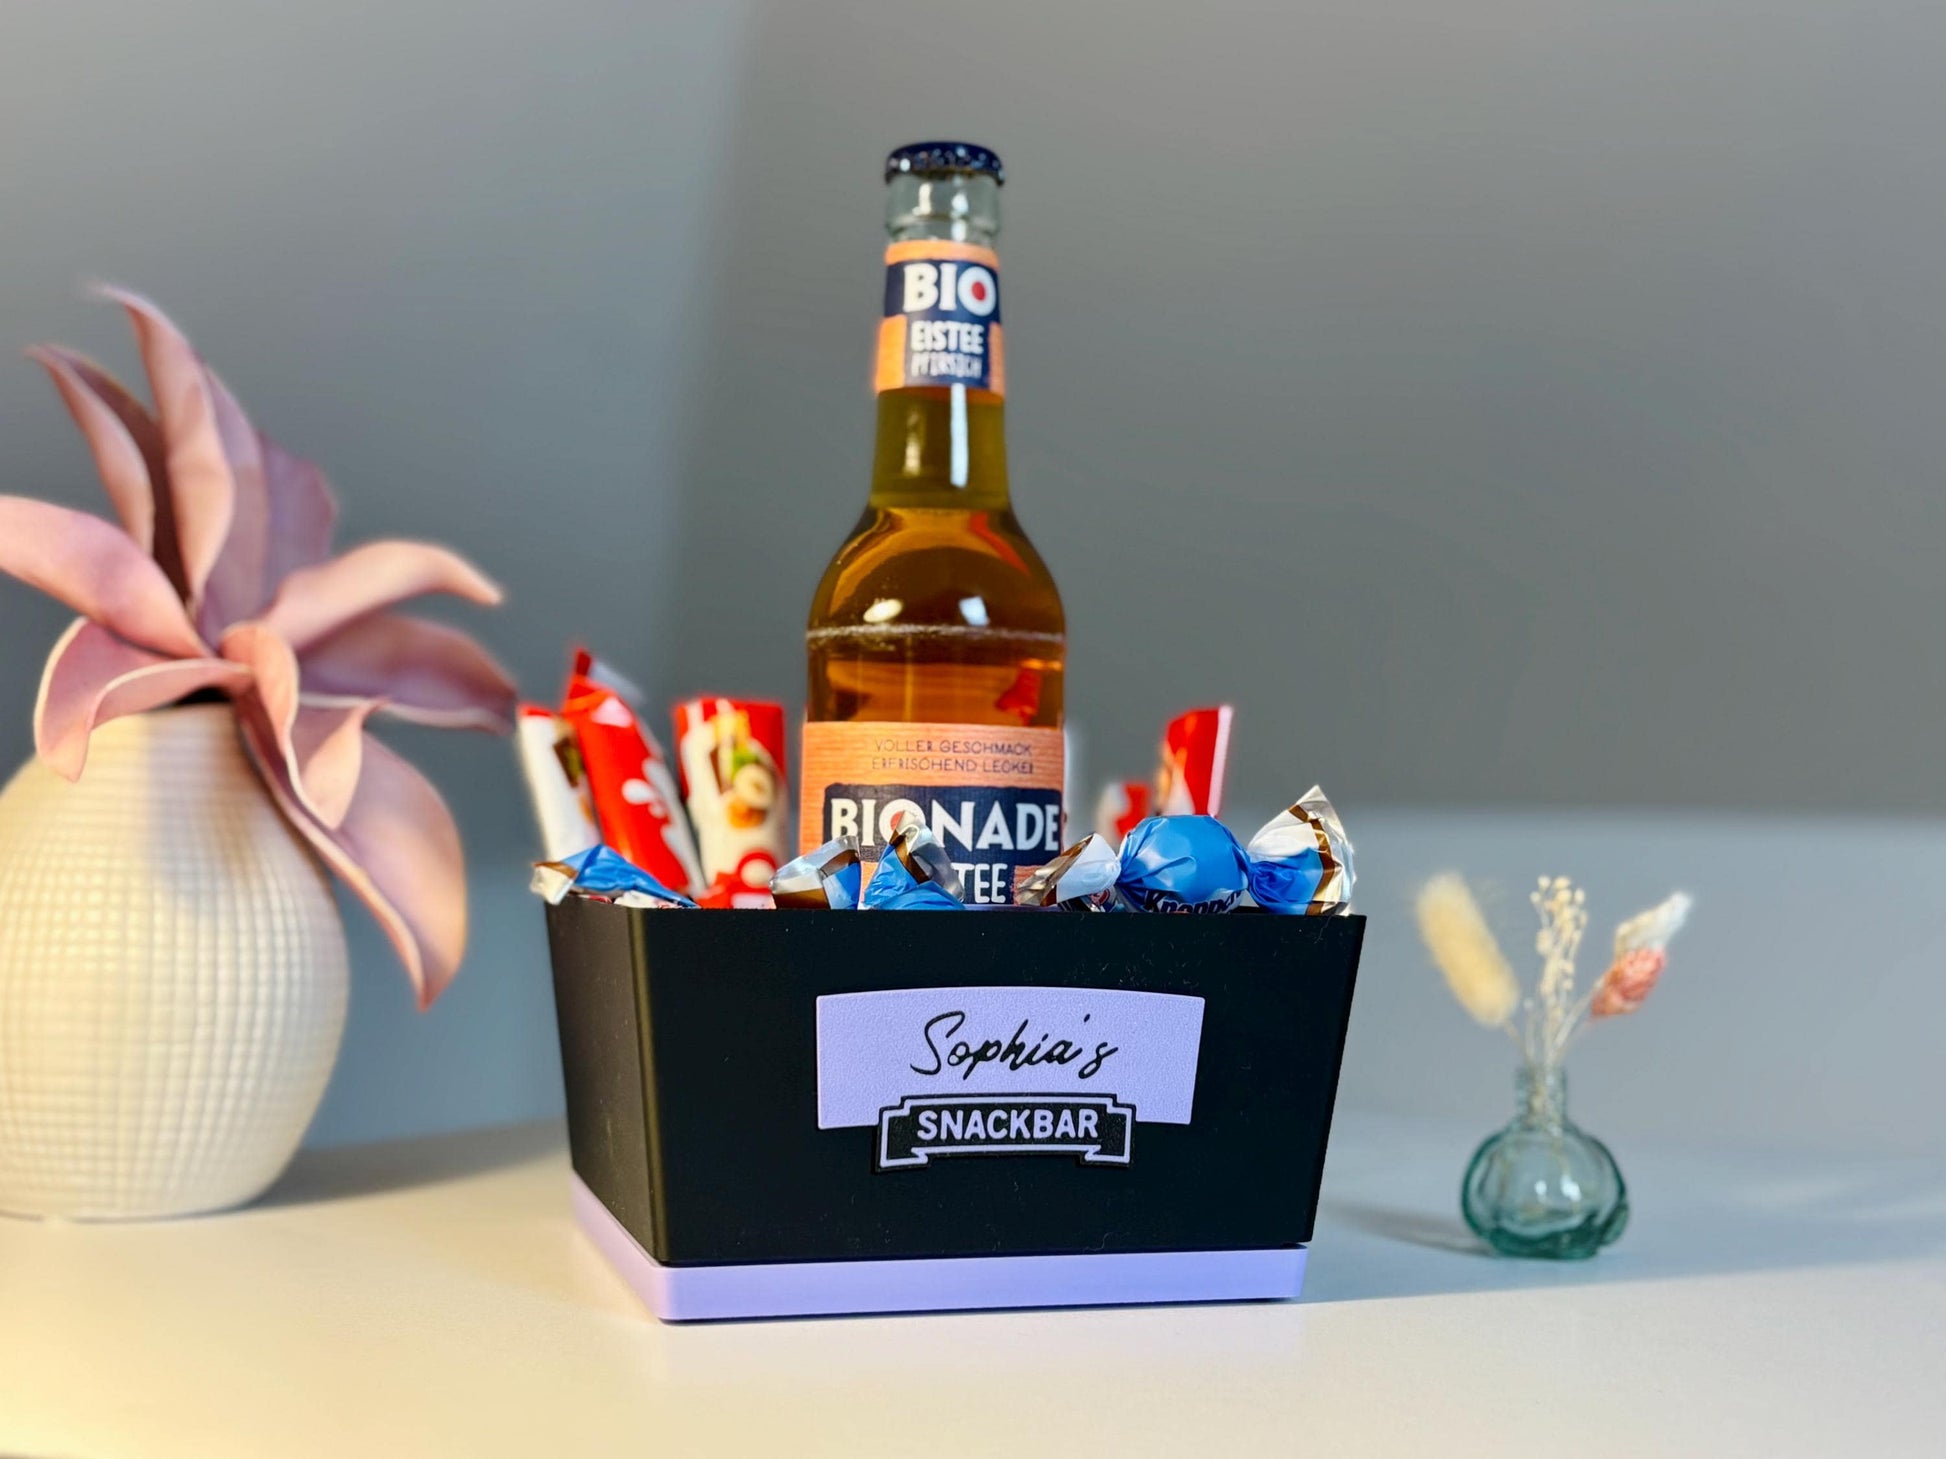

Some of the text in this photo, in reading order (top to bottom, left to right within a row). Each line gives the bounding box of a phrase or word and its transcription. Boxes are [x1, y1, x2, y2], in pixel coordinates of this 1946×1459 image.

[902, 262, 997, 317] BIO
[910, 320, 985, 355] EISTEE
[871, 757, 978, 772] ERFRISCHEND
[875, 739, 1033, 756] VOLLER GESCHMACK
[830, 798, 1060, 852] BIONADE
[910, 1010, 1119, 1080] Sophia's
[916, 1108, 1099, 1141] SNACKBAR
